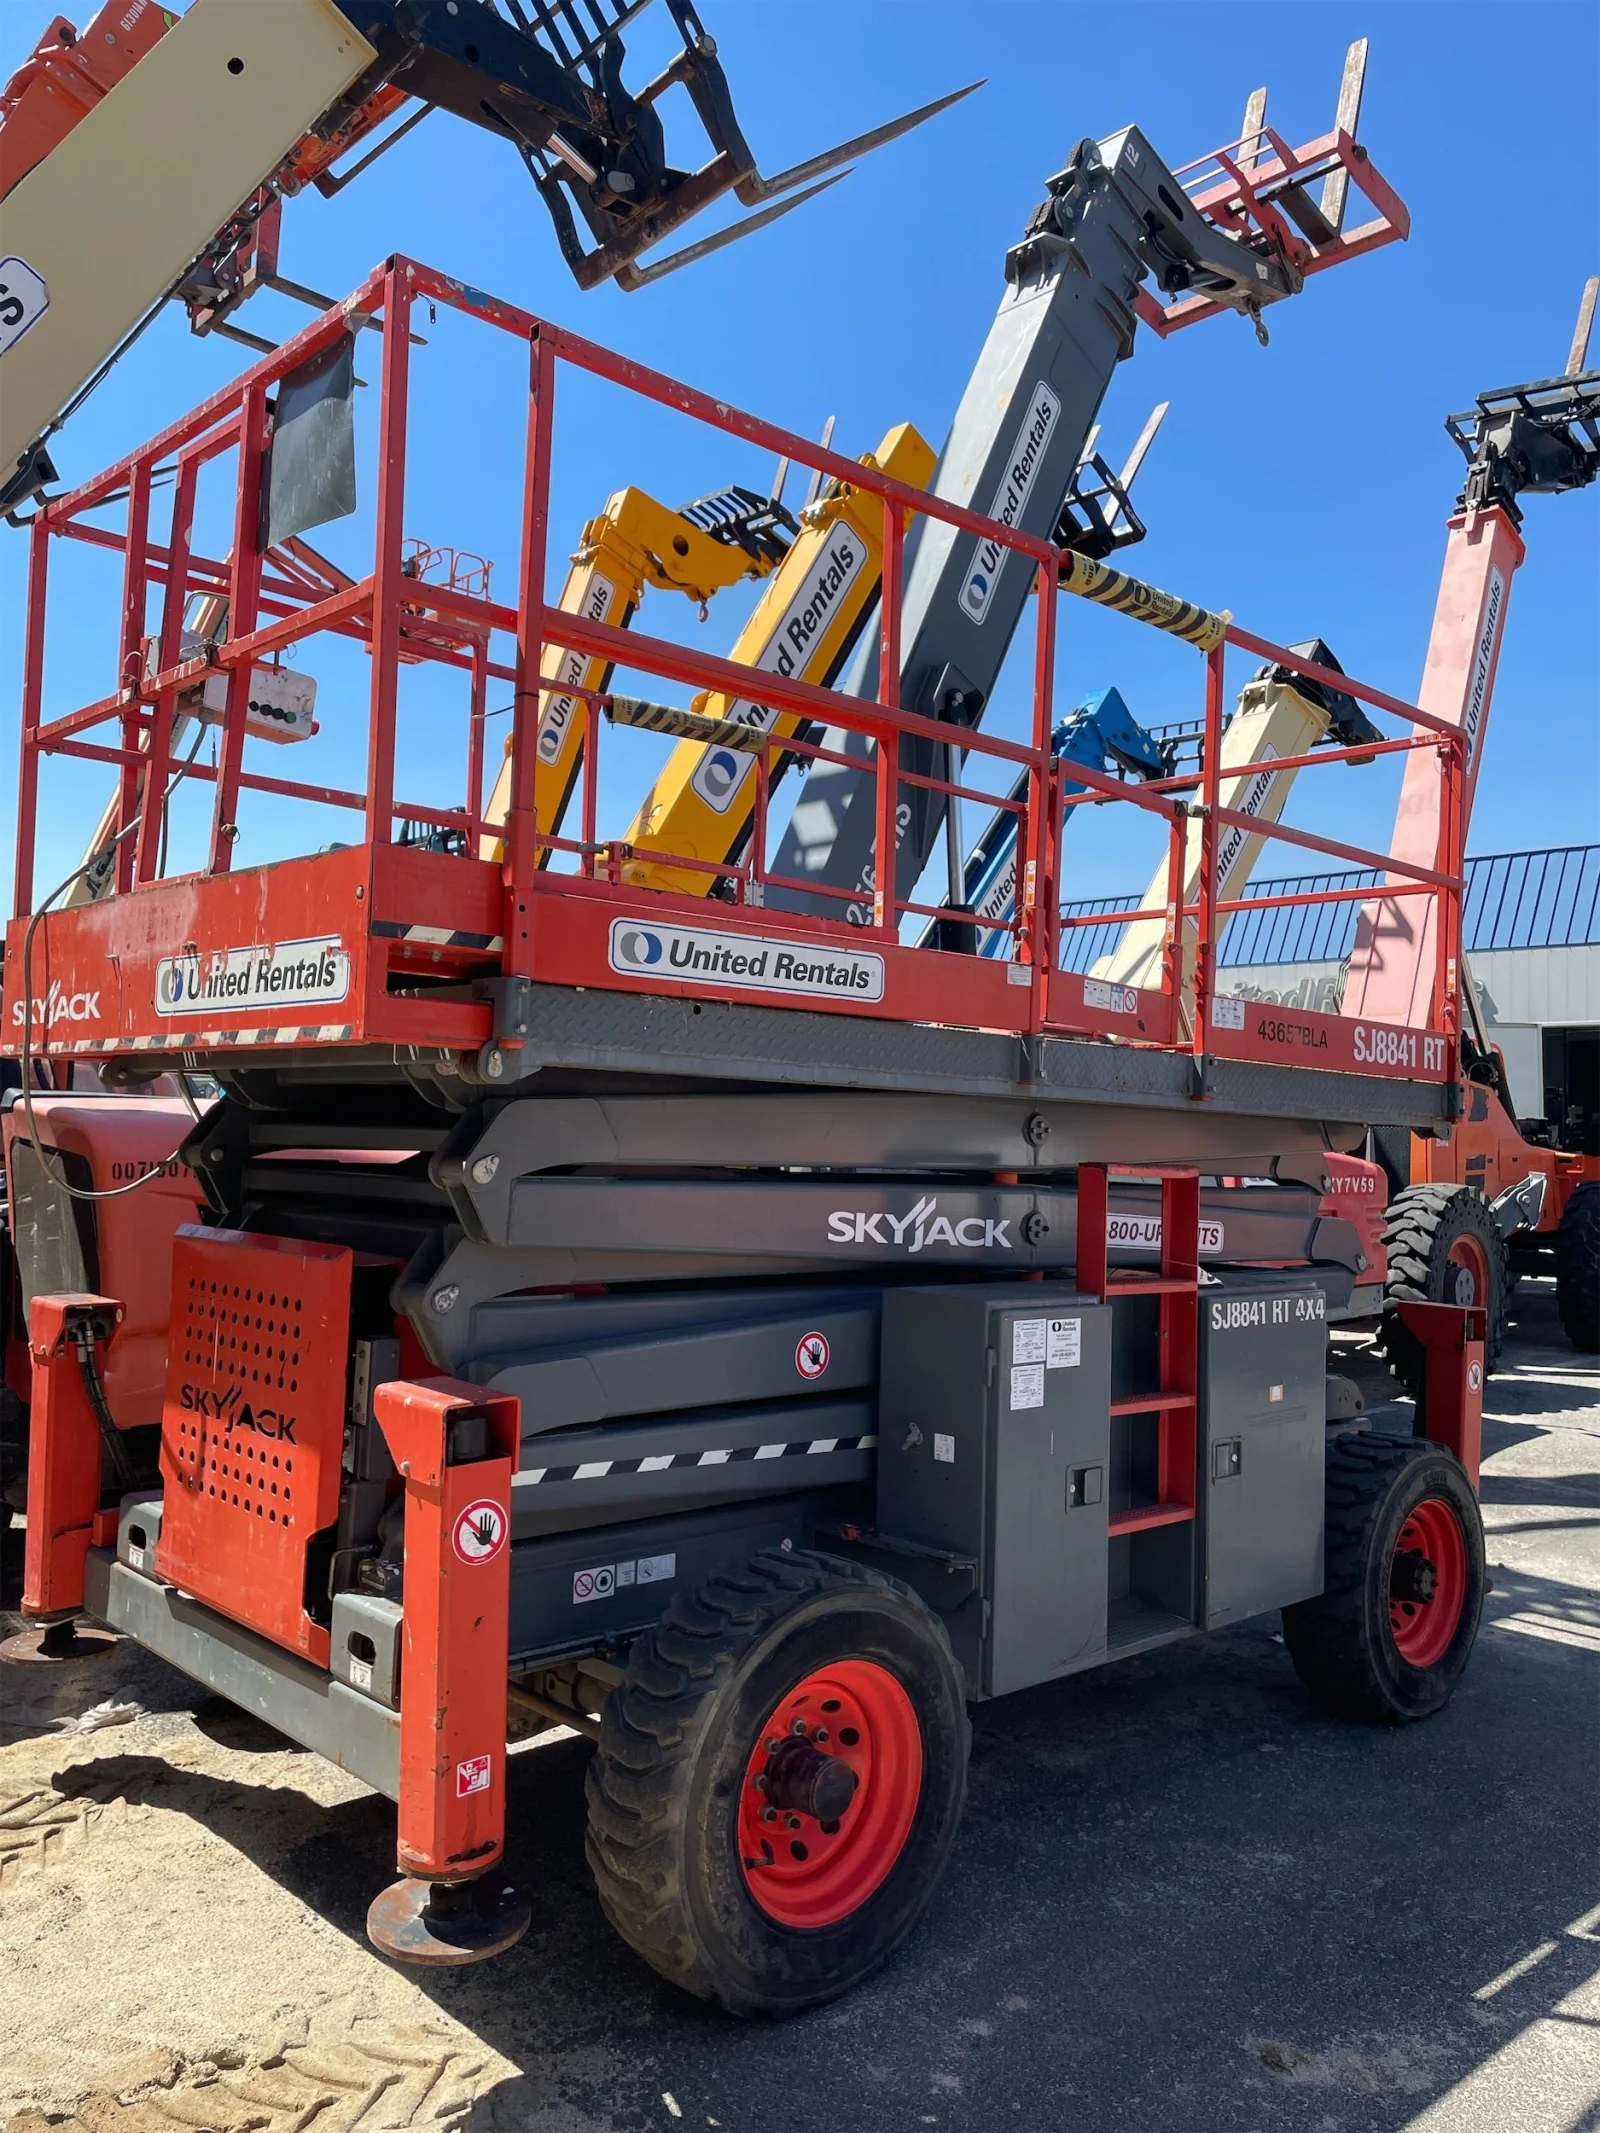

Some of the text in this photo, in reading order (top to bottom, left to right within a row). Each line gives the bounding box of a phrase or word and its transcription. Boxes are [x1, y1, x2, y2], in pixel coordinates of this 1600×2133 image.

[980, 401, 1052, 574] Uned Rentals
[787, 543, 854, 654] Rentals
[1151, 602, 1174, 619] Rentals
[1153, 591, 1174, 608] United
[1467, 580, 1501, 735] United Rentals
[550, 657, 582, 728] Uned
[1210, 769, 1275, 890] nited enta
[187, 952, 336, 1001] United Rentals
[669, 938, 870, 989] United Rentals
[12, 979, 101, 1029] SKYJACK
[1353, 1026, 1445, 1071] SJ8841 RT
[827, 1196, 1013, 1252] SKYJACK
[1212, 1299, 1325, 1330] SJ8841 RT 4X4
[180, 1382, 297, 1446] SKYJACK
